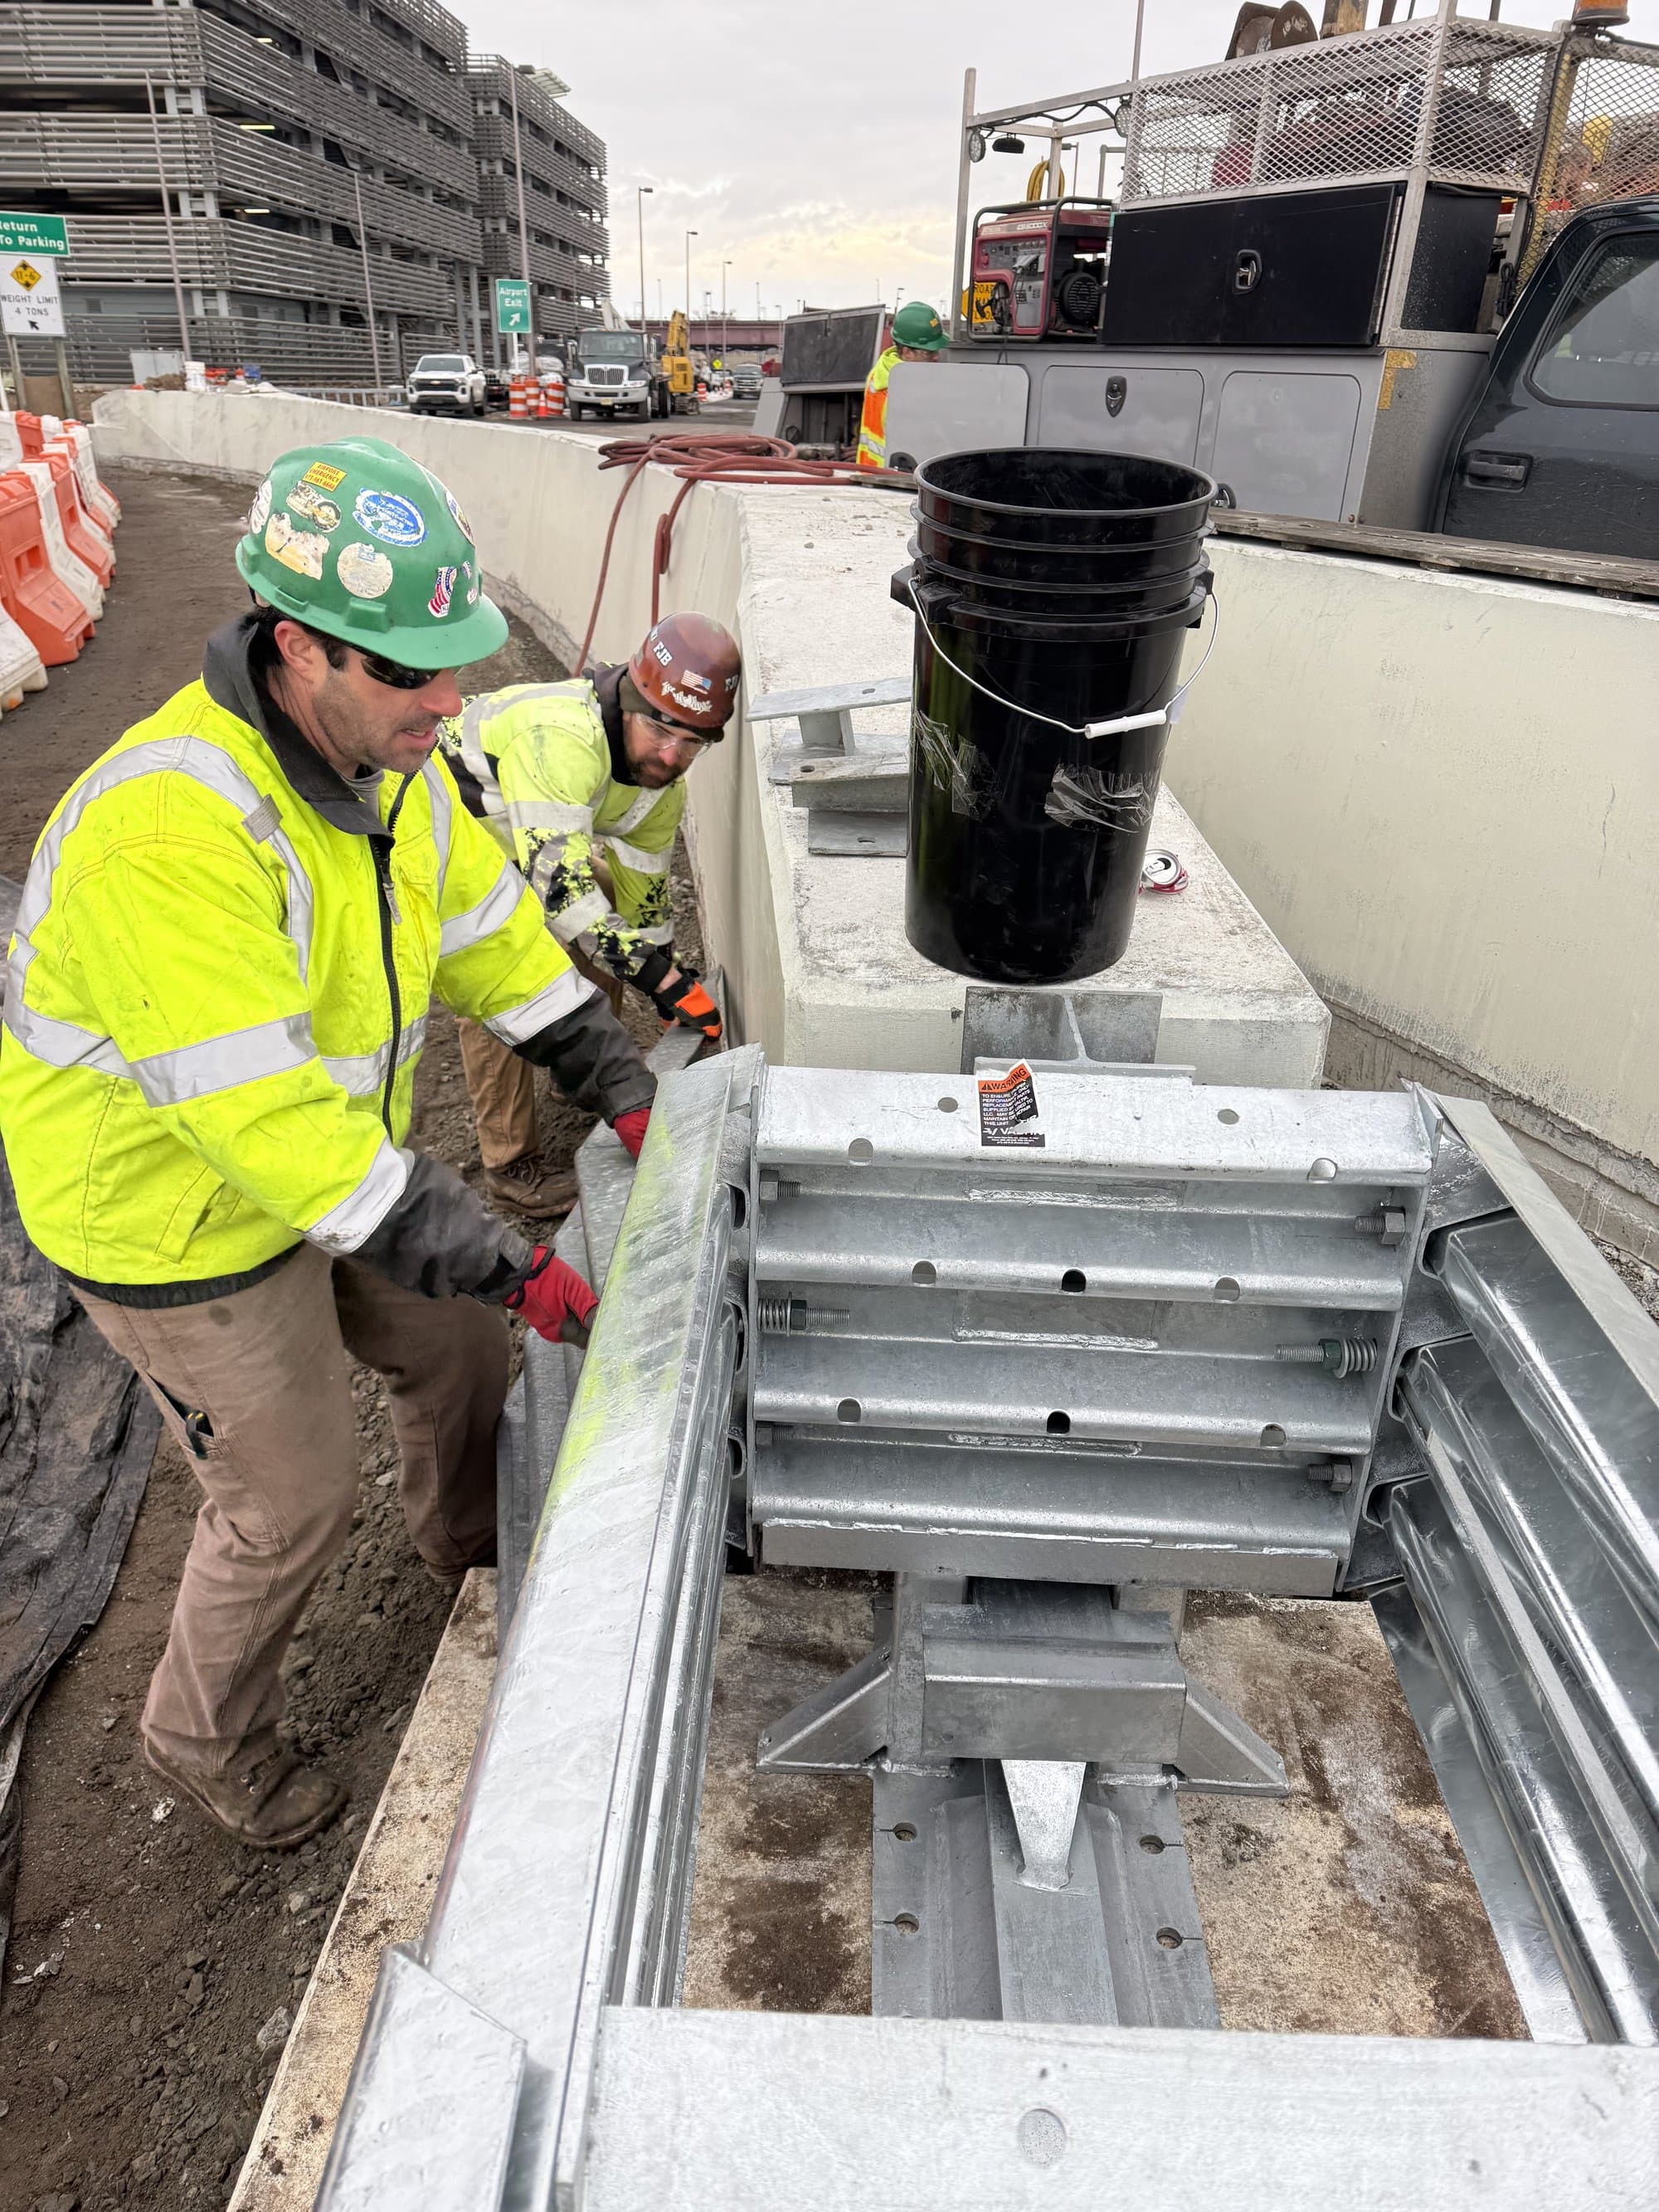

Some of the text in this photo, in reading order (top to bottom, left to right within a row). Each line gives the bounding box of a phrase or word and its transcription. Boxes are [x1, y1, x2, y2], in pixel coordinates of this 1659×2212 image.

[18, 236, 65, 251] Parking
[499, 287, 528, 297] Airport
[1, 295, 59, 305] WEIGHT LIMIT
[504, 298, 523, 307] Exit
[15, 307, 49, 316] 4 TONS
[653, 641, 673, 666] FJB
[991, 1068, 1027, 1090] WARNING
[1026, 1097, 1034, 1105] TO
